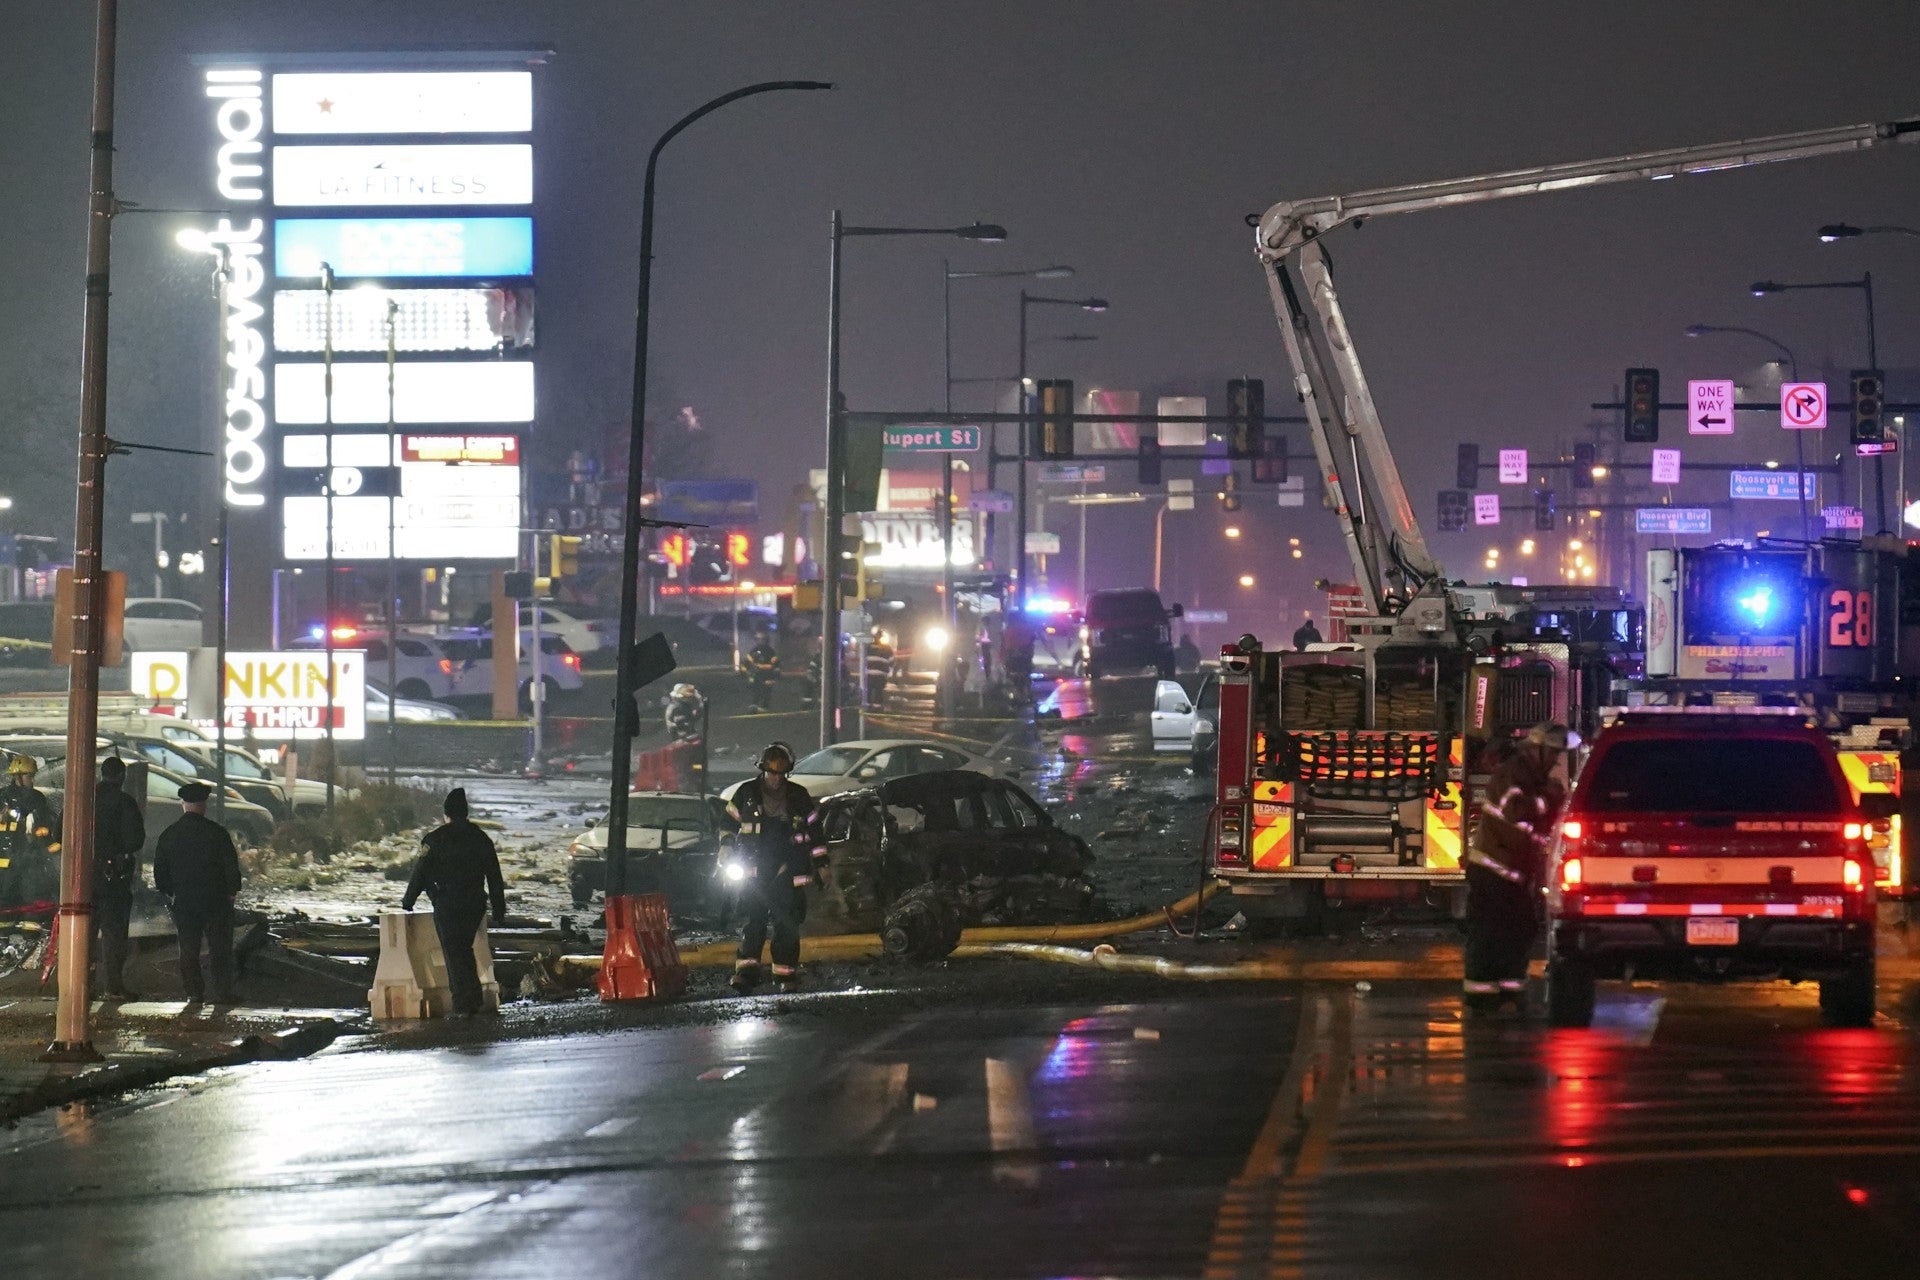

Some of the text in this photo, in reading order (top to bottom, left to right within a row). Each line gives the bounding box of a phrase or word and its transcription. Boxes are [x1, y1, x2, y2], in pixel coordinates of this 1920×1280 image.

[319, 175, 488, 194] LA FITNESS
[206, 69, 265, 506] roosevelt mall
[1697, 386, 1725, 397] ONE
[1697, 400, 1725, 411] WAY
[951, 429, 970, 445] St
[1735, 474, 1811, 485] Roosevelt Bld
[1640, 511, 1707, 520] Roosevelt Blvd
[1830, 590, 1871, 647] 28
[1689, 645, 1785, 657] PHILADELPHIA
[149, 662, 348, 699] DNKIN'
[1477, 678, 1487, 702] KEEP
[253, 706, 319, 727] THRU
